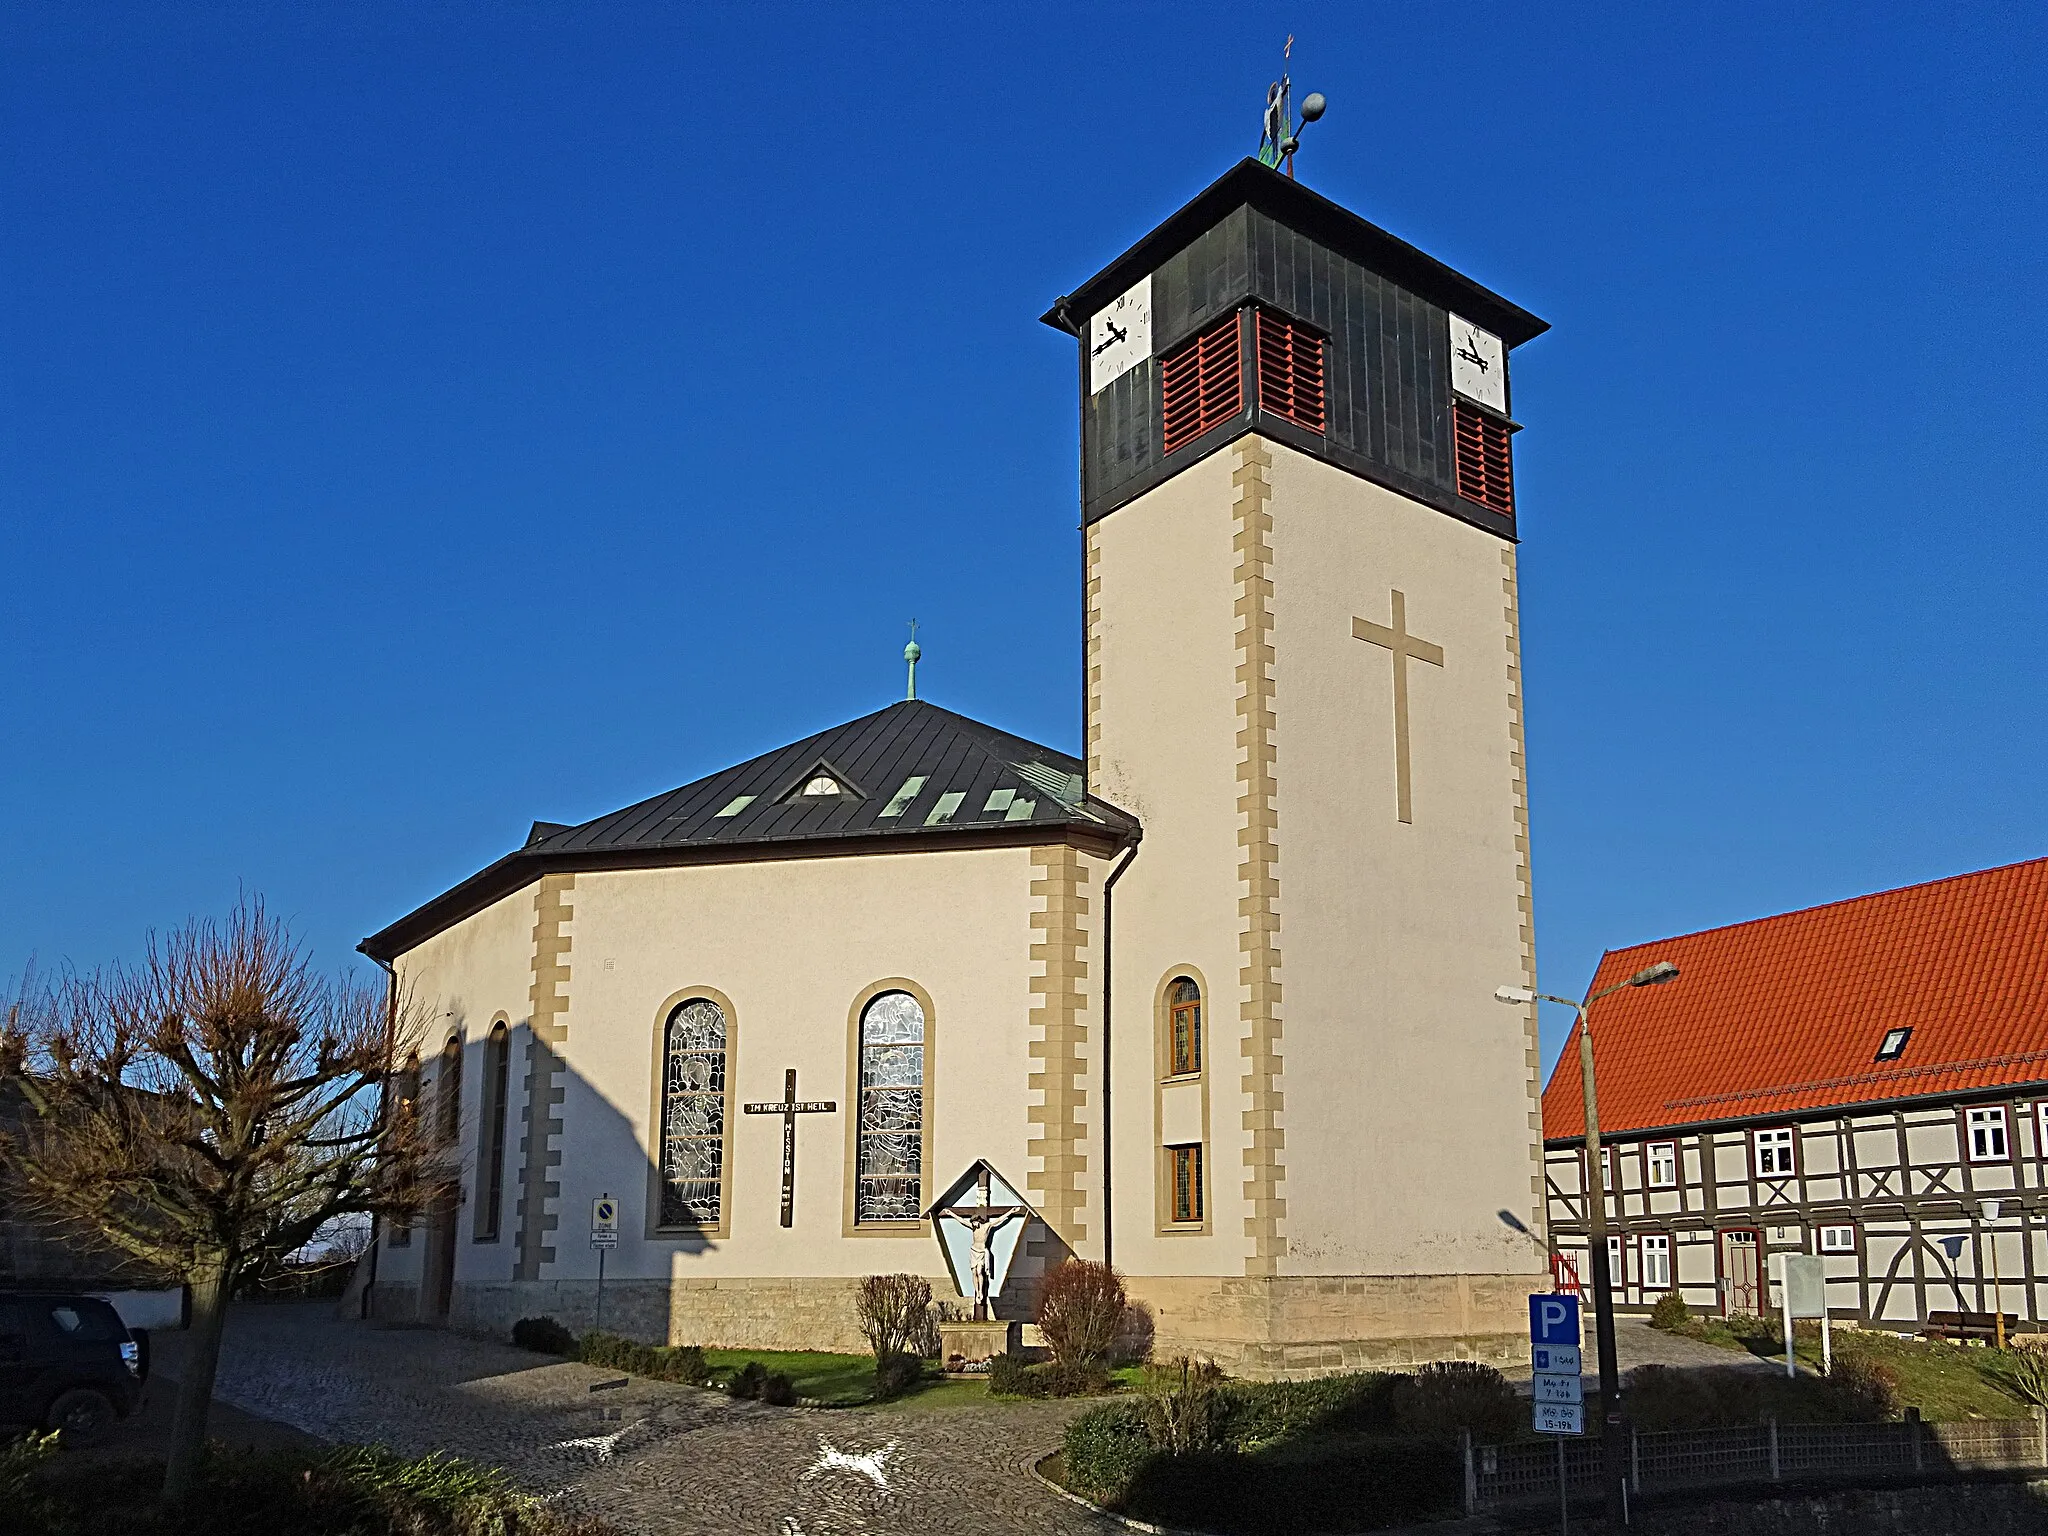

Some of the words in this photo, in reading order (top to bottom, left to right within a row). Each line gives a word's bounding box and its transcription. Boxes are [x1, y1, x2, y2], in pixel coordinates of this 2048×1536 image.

[750, 1104, 760, 1112] IM
[763, 1103, 789, 1112] KREUZ
[791, 1103, 805, 1111] IST
[807, 1102, 828, 1111] HEIL
[784, 1123, 792, 1175] MISSION
[1541, 1301, 1567, 1338] P
[1544, 1419, 1572, 1430] 15-19h
